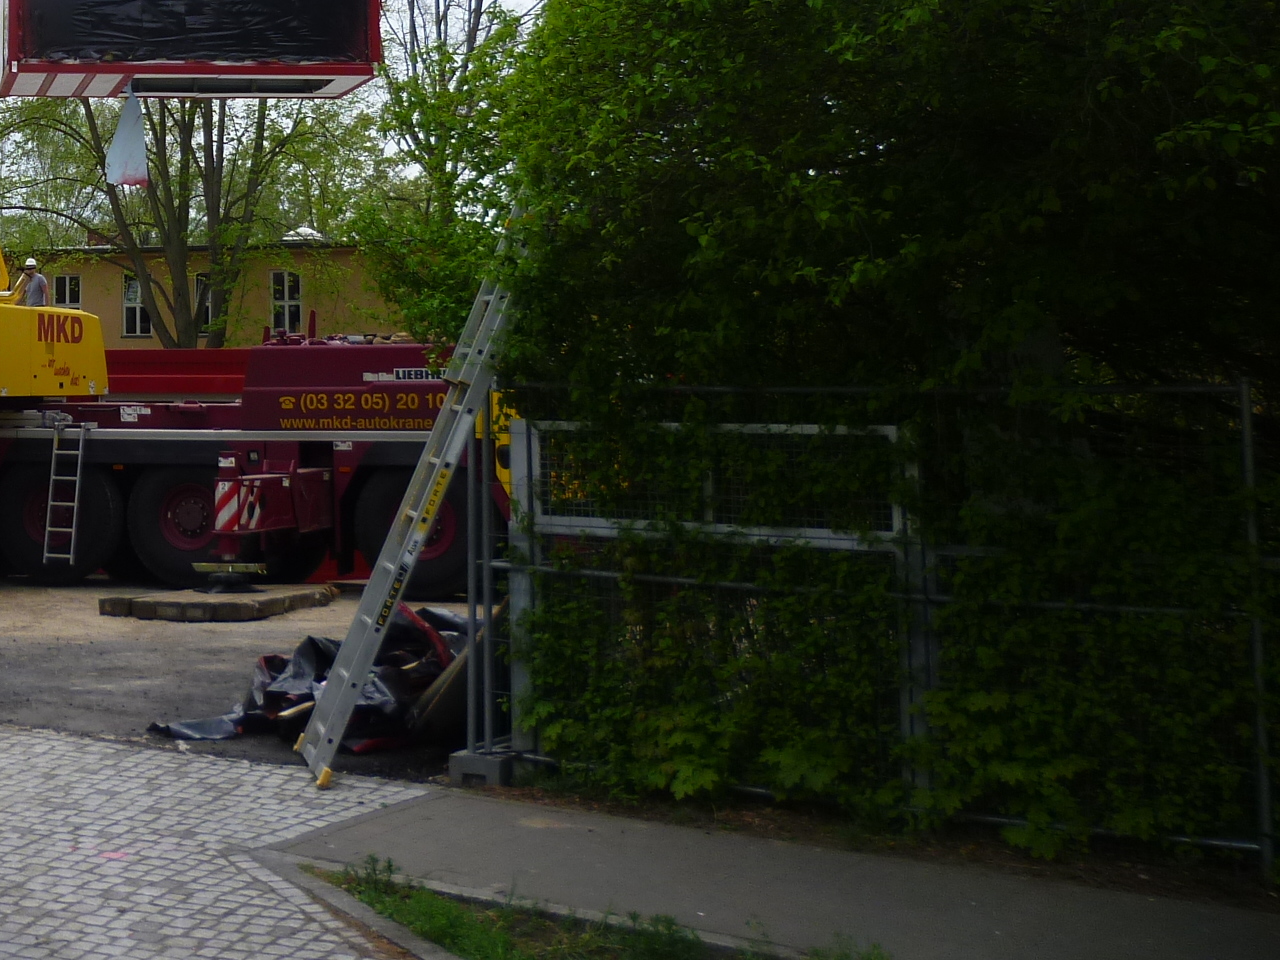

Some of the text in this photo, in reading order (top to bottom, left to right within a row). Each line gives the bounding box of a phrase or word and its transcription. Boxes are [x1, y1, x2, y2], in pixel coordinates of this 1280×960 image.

[37, 312, 84, 344] MKD
[395, 369, 447, 380] LIEBHE
[300, 393, 447, 413] (03 32 05) 20 10
[425, 471, 448, 516] FORTE
[377, 580, 402, 626] FORTE
